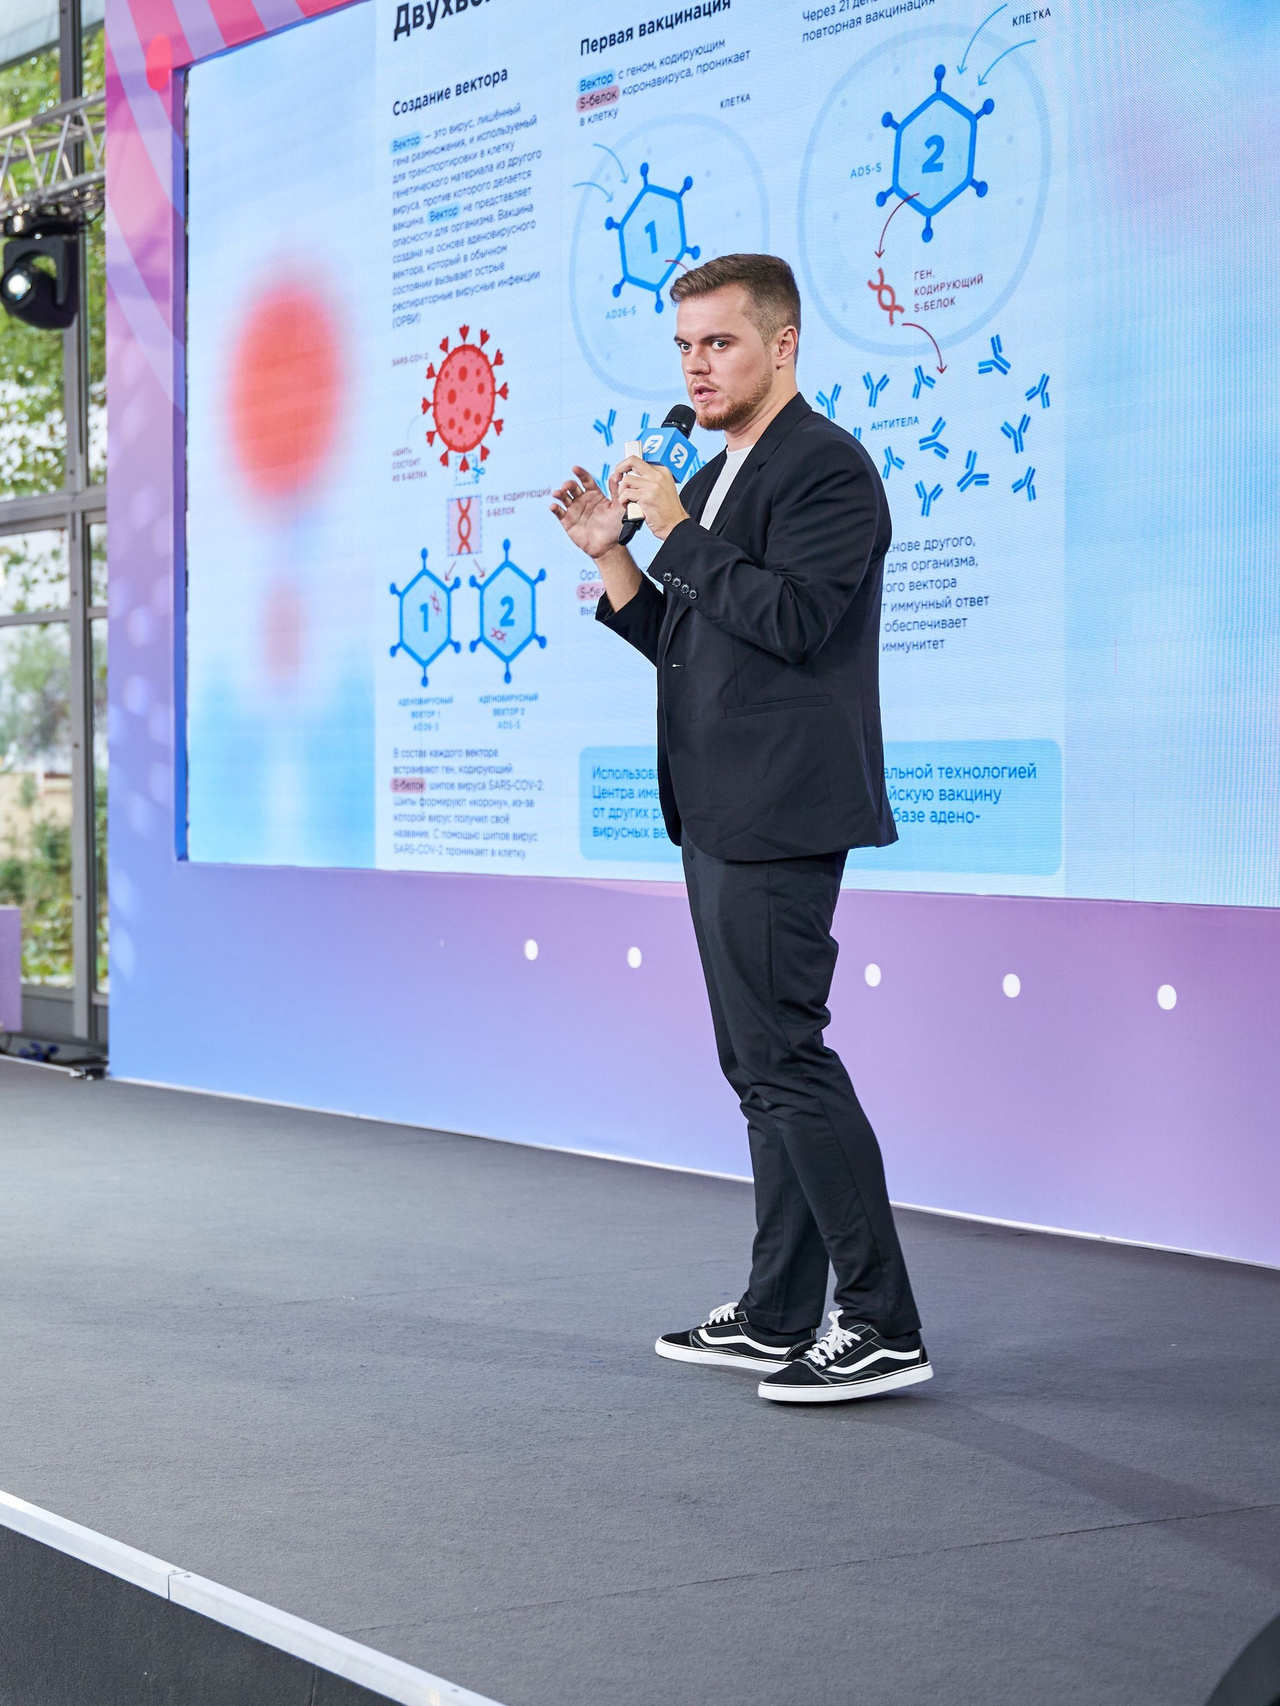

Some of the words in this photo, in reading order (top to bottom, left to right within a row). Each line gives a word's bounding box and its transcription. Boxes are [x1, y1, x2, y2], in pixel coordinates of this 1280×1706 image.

[802, 5, 835, 23] Через
[839, 0, 850, 14] 21
[1012, 7, 1051, 26] КЛЕТКА
[580, 27, 633, 56] Первая
[638, 0, 731, 38] вакцинация
[802, 15, 861, 43] повторная
[580, 73, 613, 91] Вектор
[618, 71, 623, 80] с
[626, 61, 656, 77] геном,
[659, 39, 725, 67] кодирующим
[579, 90, 617, 110] S-белок
[622, 68, 693, 96] коронавируса,
[696, 50, 751, 76] проникает
[393, 87, 451, 116] Создание
[455, 68, 508, 96] вектора
[720, 93, 751, 109] КЛЕТКА
[580, 117, 584, 127] в
[588, 107, 618, 124] клетку
[393, 135, 420, 151] Вектор
[434, 128, 446, 139] это
[393, 155, 409, 167] гена
[477, 115, 537, 142] используемый
[393, 172, 406, 184] для
[409, 152, 478, 179] транспортировки
[487, 141, 515, 156] клетку
[922, 135, 945, 173] 2
[392, 176, 448, 199] генетического
[451, 163, 493, 182] материала
[496, 161, 505, 170] из
[508, 150, 542, 168] другого
[850, 163, 882, 178] AD5-S
[423, 192, 451, 207] против
[453, 181, 491, 199] которого
[493, 170, 531, 189] делается
[430, 207, 459, 222] Вектор
[463, 203, 472, 212] не
[475, 187, 531, 209] представляет
[392, 231, 432, 247] опасности
[434, 226, 448, 237] для
[498, 204, 534, 220] Вакцина
[393, 250, 423, 263] создана
[426, 246, 434, 254] на
[437, 238, 464, 252] основе
[467, 220, 536, 245] аденовирусного
[645, 220, 658, 254] 1
[427, 254, 460, 271] который
[470, 245, 507, 261] обычном
[393, 280, 432, 295] состоянии
[435, 269, 472, 286] вызывает
[475, 262, 505, 276] острые
[914, 273, 983, 296] КОДИРУЮЩИЙ
[392, 291, 453, 314] респираторные
[456, 281, 495, 298] вирусные
[498, 271, 540, 287] инфекции
[914, 297, 956, 313] S-БЕЛОК
[392, 312, 420, 329] (ОРВИ)
[871, 416, 919, 431] АНТИТЕЛА
[503, 487, 551, 502] КОДИРУЮЩИЙ
[924, 536, 975, 551] другого,
[887, 562, 907, 574] для
[911, 556, 978, 572] организма,
[909, 578, 957, 591] вектора
[500, 596, 515, 626] 2
[891, 596, 951, 613] иммунный
[955, 595, 989, 607] ответ
[420, 603, 429, 632] 1
[885, 618, 967, 632] обеспечивает
[882, 639, 945, 653] иммунитет
[401, 749, 427, 758] состав
[429, 749, 463, 759] каждого
[466, 749, 499, 758] вектора
[394, 765, 438, 775] встраивают
[459, 763, 513, 775] кодирующий
[938, 762, 1037, 779] технологией
[394, 780, 425, 791] S-белок
[429, 782, 455, 790] шипов
[458, 781, 486, 792] вируса
[592, 785, 634, 801] Центра
[939, 788, 1002, 805] вакцину
[420, 797, 466, 808] формируют
[512, 799, 535, 808] из-за
[394, 812, 426, 823] которой
[429, 814, 451, 824] вирус
[455, 815, 488, 825] получил
[593, 807, 605, 818] от
[608, 808, 649, 821] других
[893, 807, 925, 823] базе
[929, 810, 980, 825] адено-
[442, 831, 480, 841] помощью
[483, 832, 510, 841] шипов
[513, 832, 538, 844] вирус
[592, 827, 650, 840] вирусных
[446, 847, 488, 857] проникает
[498, 849, 527, 860] клетку
